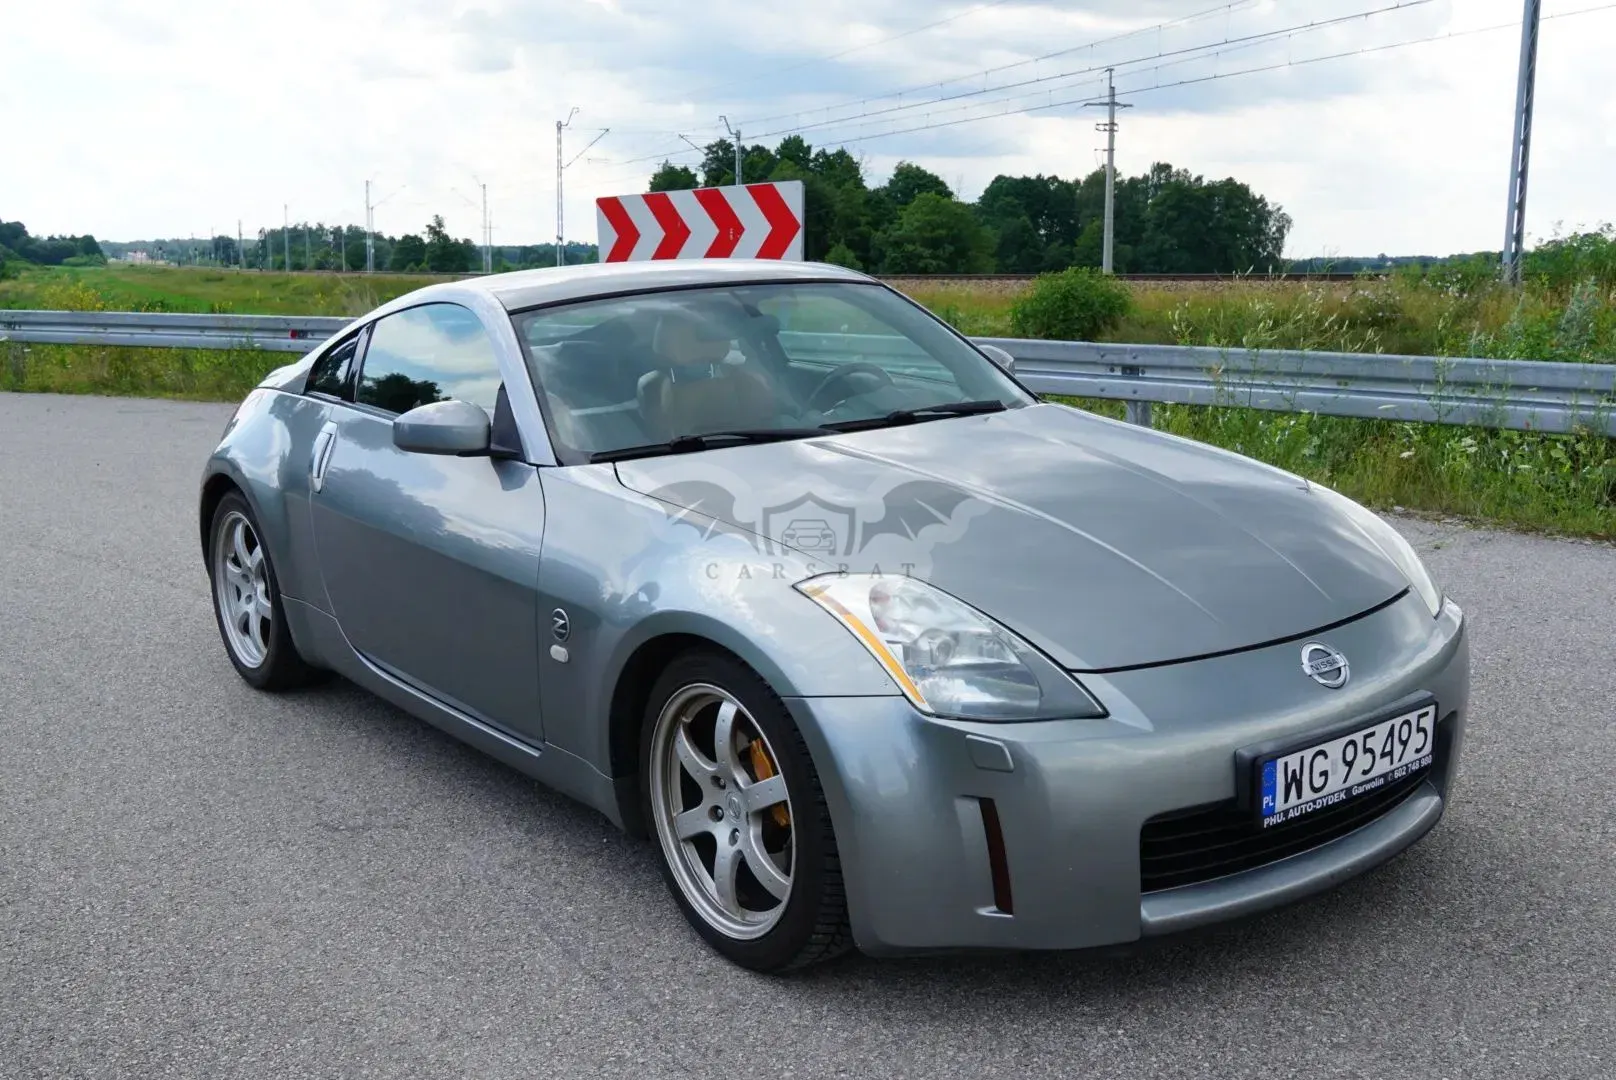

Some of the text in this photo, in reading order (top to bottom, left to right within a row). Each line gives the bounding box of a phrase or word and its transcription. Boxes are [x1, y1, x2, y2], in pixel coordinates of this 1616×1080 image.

[1310, 656, 1342, 672] NISSA
[1283, 710, 1430, 805] WG 95495
[1263, 812, 1287, 829] PHU.
[1287, 790, 1346, 819] AUTO-DYDEK
[1351, 777, 1385, 796] Garwolin
[1394, 766, 1407, 778] 602
[1263, 795, 1274, 808] PL
